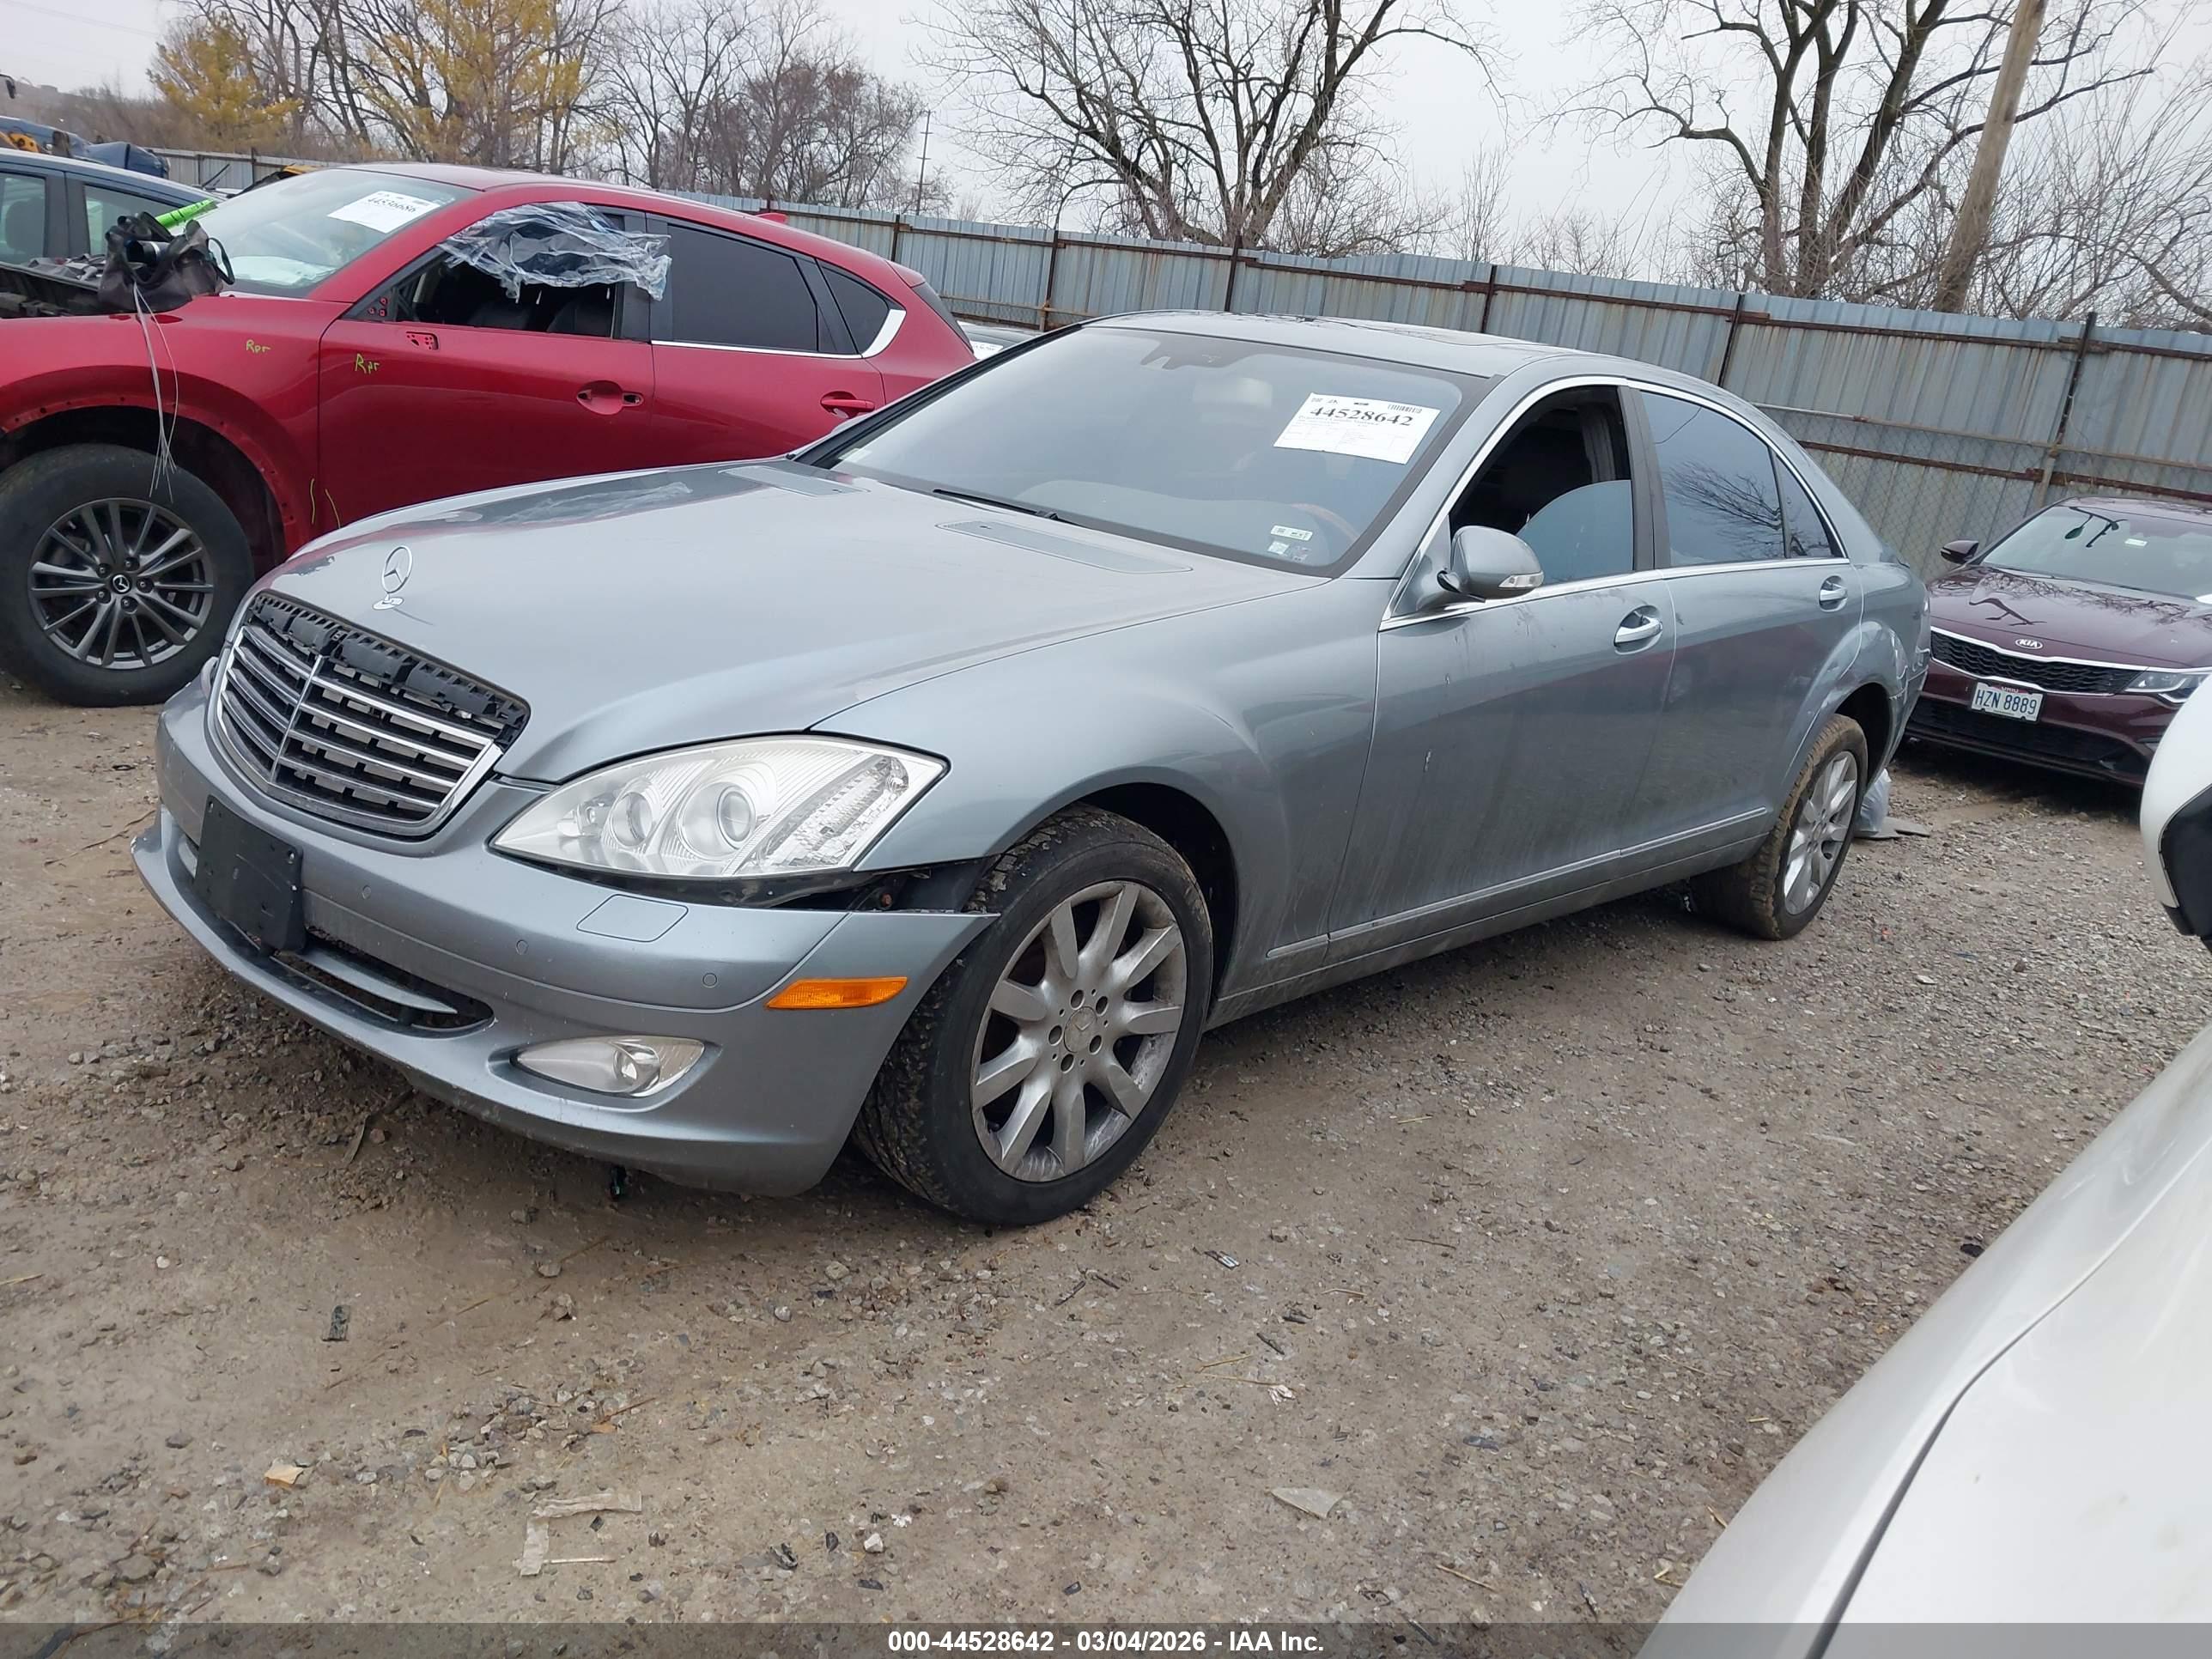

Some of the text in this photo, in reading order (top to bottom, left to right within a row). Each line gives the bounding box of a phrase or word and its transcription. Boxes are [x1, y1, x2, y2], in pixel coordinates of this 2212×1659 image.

[1310, 406, 1413, 427] 44528642
[2018, 639, 2039, 648] KIA
[1975, 690, 2037, 714] HZN 8889
